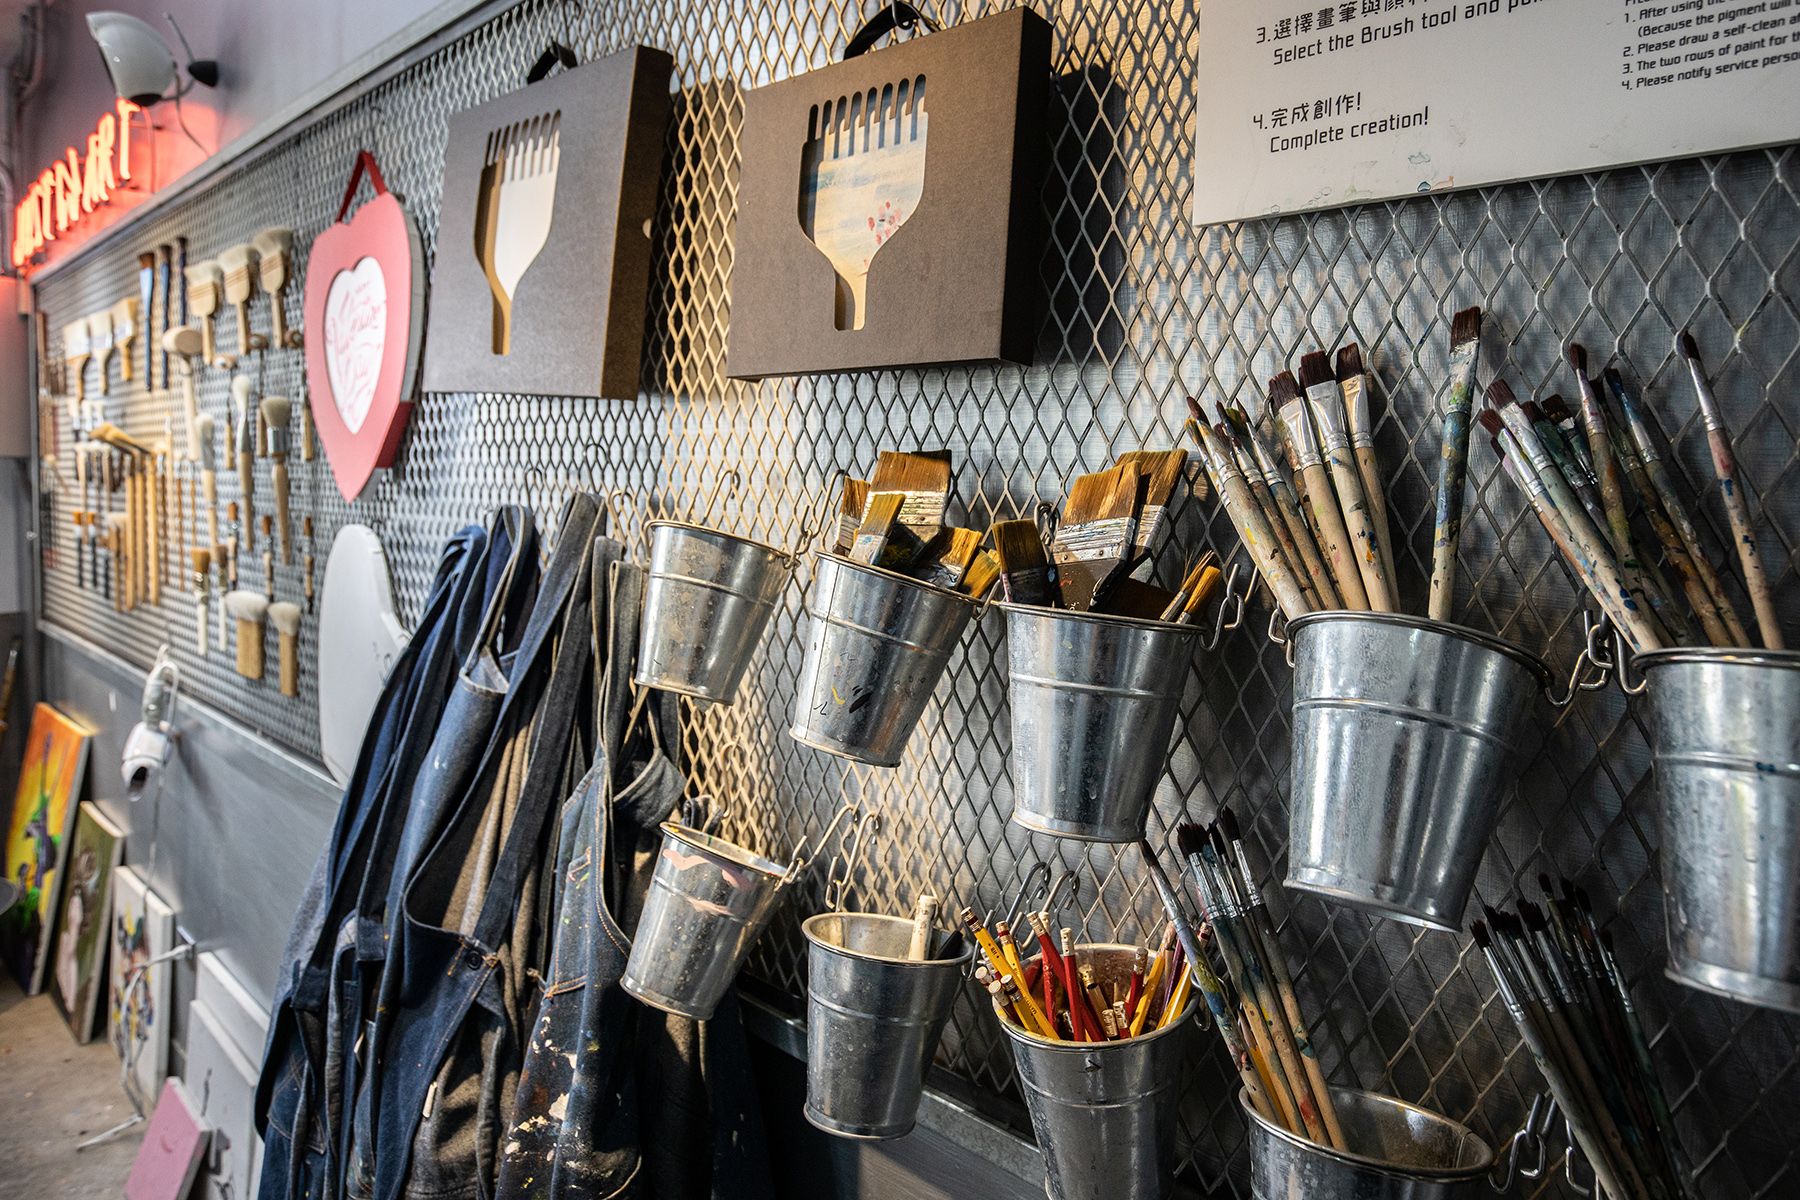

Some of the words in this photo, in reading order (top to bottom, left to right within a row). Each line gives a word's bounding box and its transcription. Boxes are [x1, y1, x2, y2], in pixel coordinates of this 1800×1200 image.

[1638, 19, 1692, 37] (Because
[1696, 14, 1714, 26] the
[1718, 2, 1766, 23] pigment
[1639, 7, 1668, 20] After
[1671, 0, 1703, 13] using
[1273, 39, 1322, 65] Select
[1328, 34, 1354, 51] the
[1361, 17, 1414, 44] Brush
[1421, 5, 1456, 29] tool
[1464, 0, 1499, 19] and
[1623, 46, 1634, 57] 2.
[1637, 40, 1676, 54] Please
[1679, 33, 1709, 46] draw
[1712, 31, 1720, 40] a
[1723, 18, 1786, 38] self-clean
[1621, 80, 1633, 91] 4.
[1636, 74, 1674, 88] Please
[1677, 66, 1711, 81] notify
[1715, 59, 1759, 74] service
[1762, 51, 1800, 68] perso
[1622, 63, 1633, 74] 3.
[1637, 60, 1656, 71] The
[1660, 56, 1681, 67] two
[1684, 49, 1715, 62] rows
[1718, 43, 1731, 56] of
[1734, 38, 1766, 55] paint
[1769, 35, 1788, 46] for
[1270, 126, 1344, 153] Complete
[1351, 106, 1429, 138] creation!
